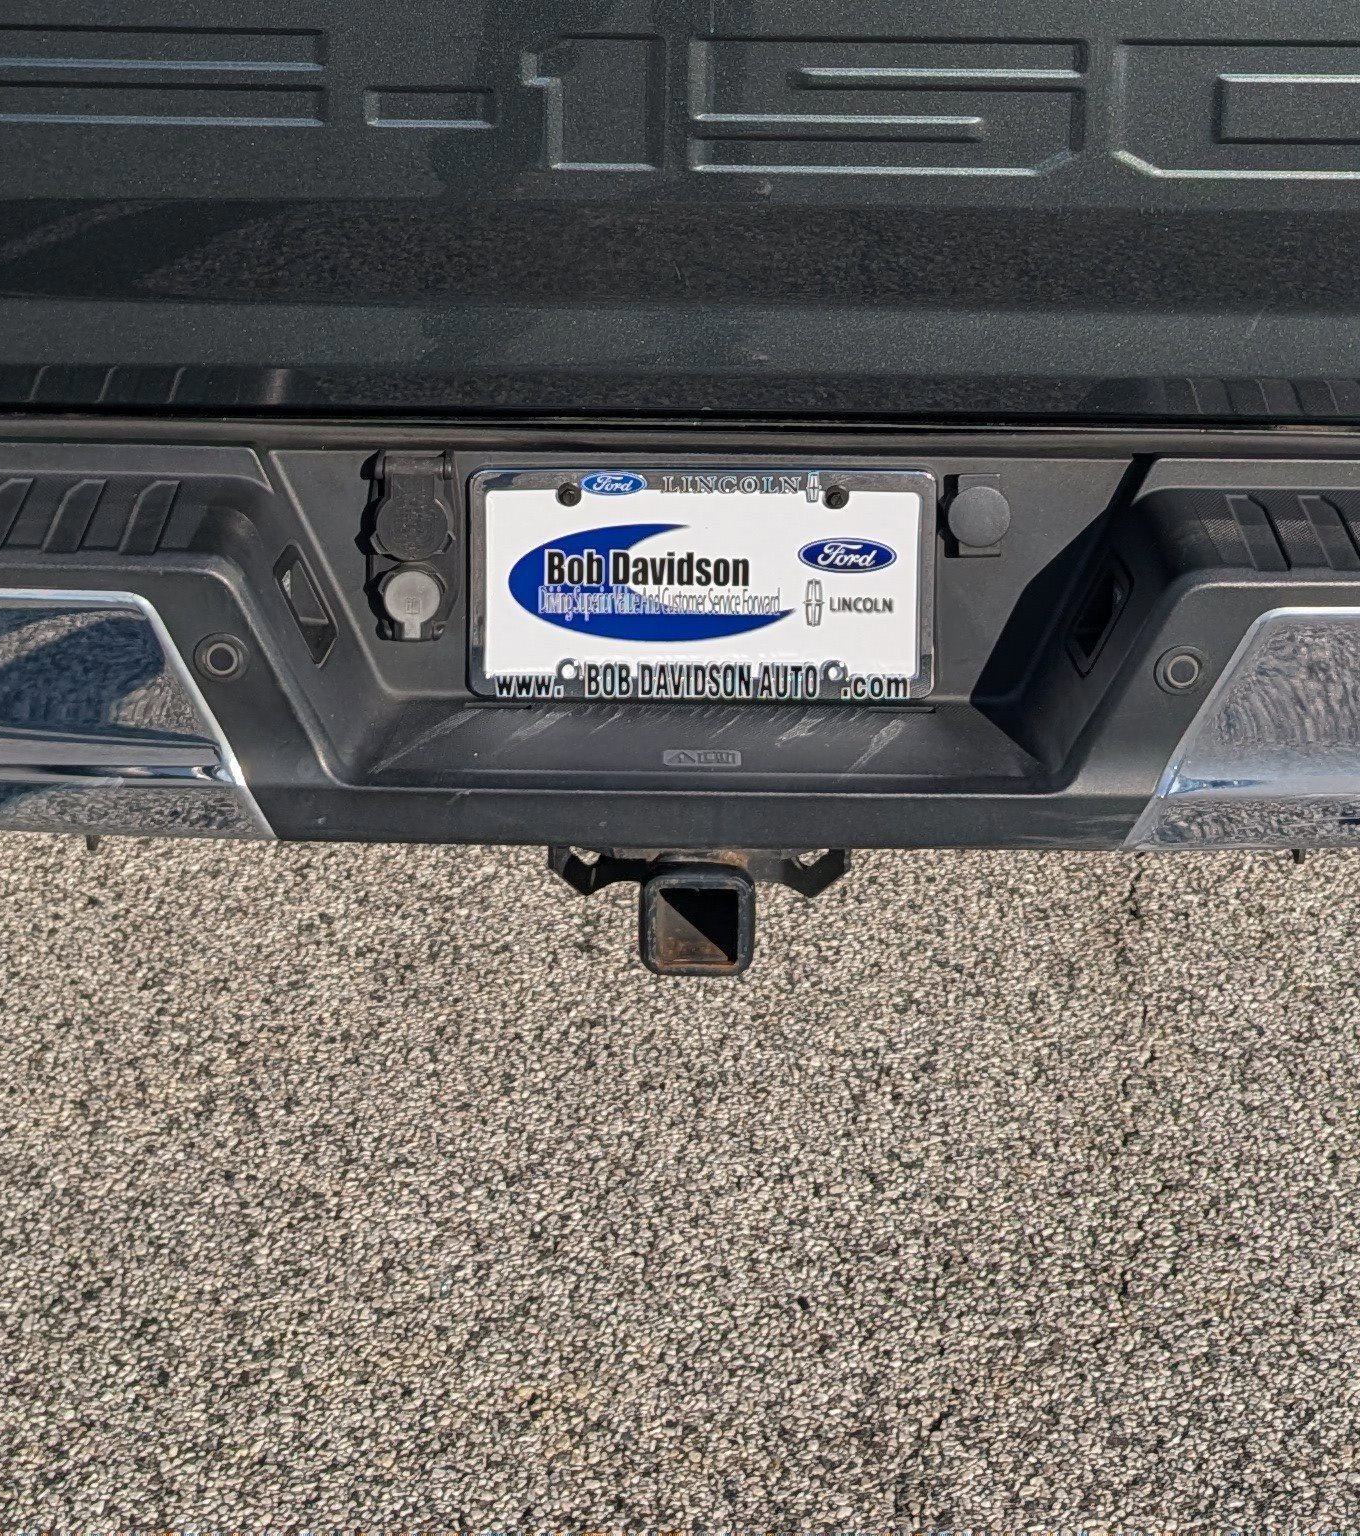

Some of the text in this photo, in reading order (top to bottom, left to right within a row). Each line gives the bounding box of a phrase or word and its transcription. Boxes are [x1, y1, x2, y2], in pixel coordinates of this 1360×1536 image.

[591, 475, 802, 494] Ford LINCOLN
[816, 542, 878, 567] Ford
[545, 550, 750, 587] Bob Davidson
[642, 585, 661, 614] And
[661, 587, 706, 614] Customer
[707, 587, 741, 614] Service
[742, 586, 781, 614] Forward
[829, 596, 894, 613] LINCOLN
[584, 661, 631, 699] BOB
[637, 661, 753, 699] DAVIDSON
[756, 661, 820, 699] AUTO
